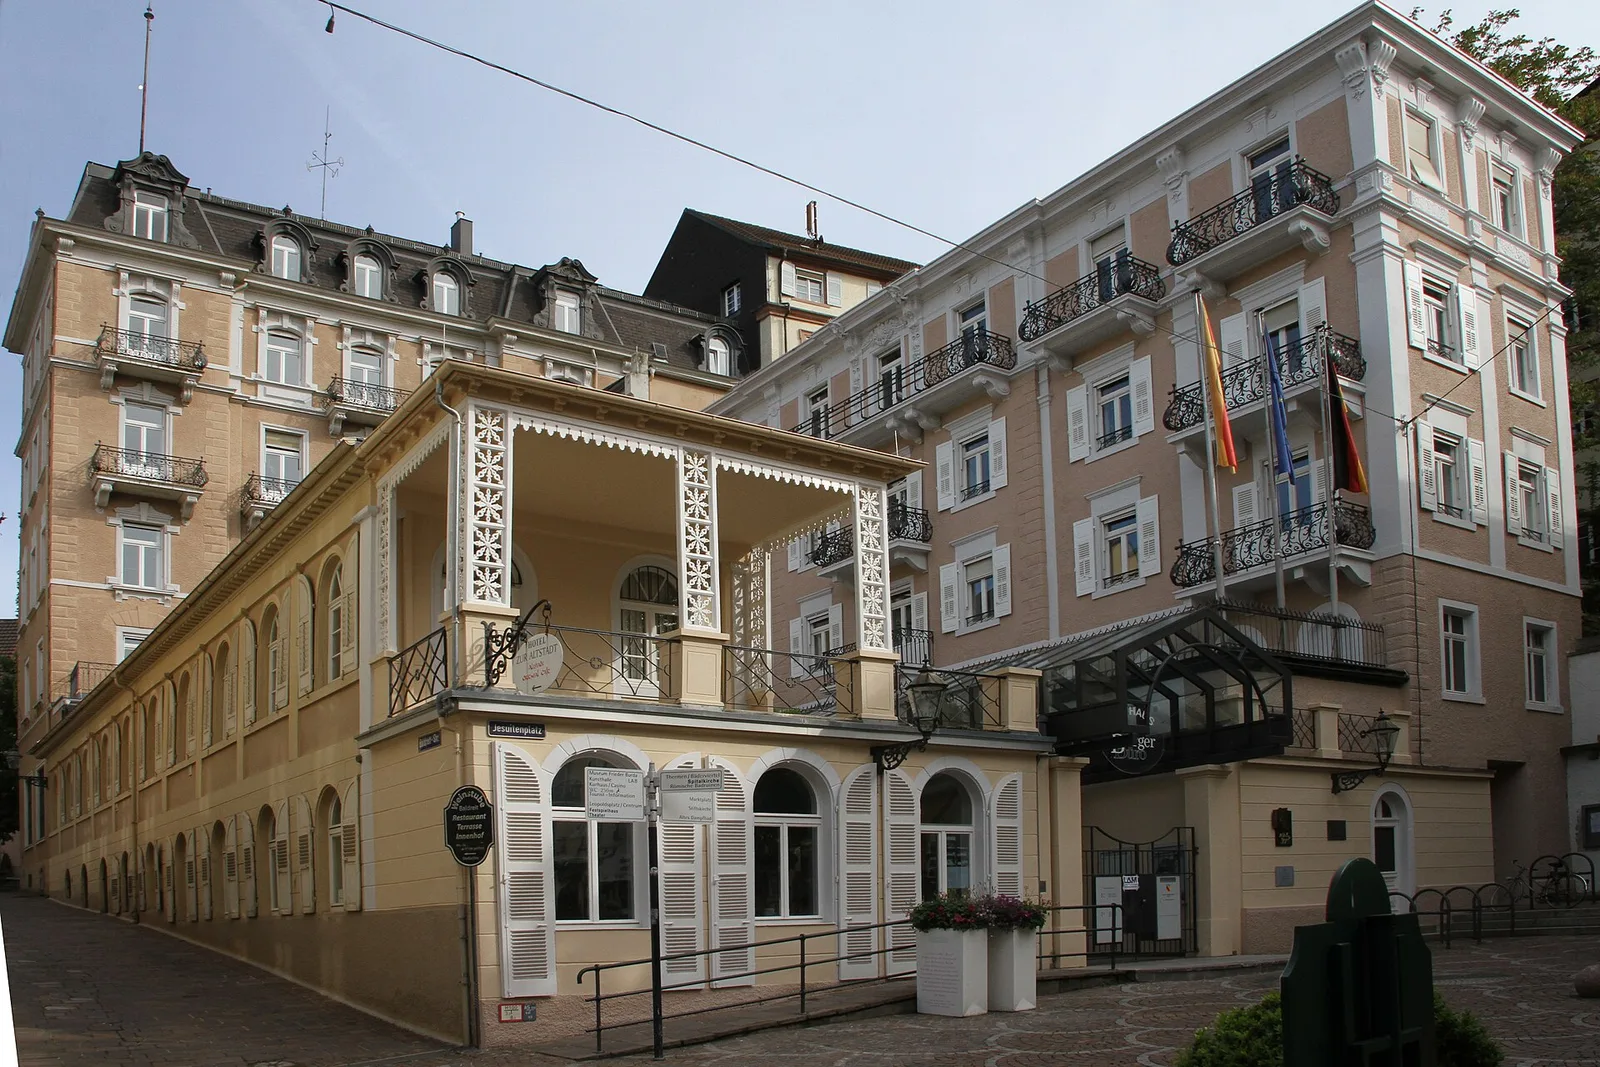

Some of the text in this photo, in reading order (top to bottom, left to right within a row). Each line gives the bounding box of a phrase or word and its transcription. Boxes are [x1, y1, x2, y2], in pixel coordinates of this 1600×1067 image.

[528, 636, 546, 649] HOTEL
[515, 643, 558, 665] ZUR ALTSTADT
[492, 723, 543, 736] Jesuitenplatz
[451, 790, 485, 811] Weinstube
[452, 813, 487, 822] Restaurant
[456, 823, 483, 831] Terrasse
[455, 831, 485, 841] Innenhof
